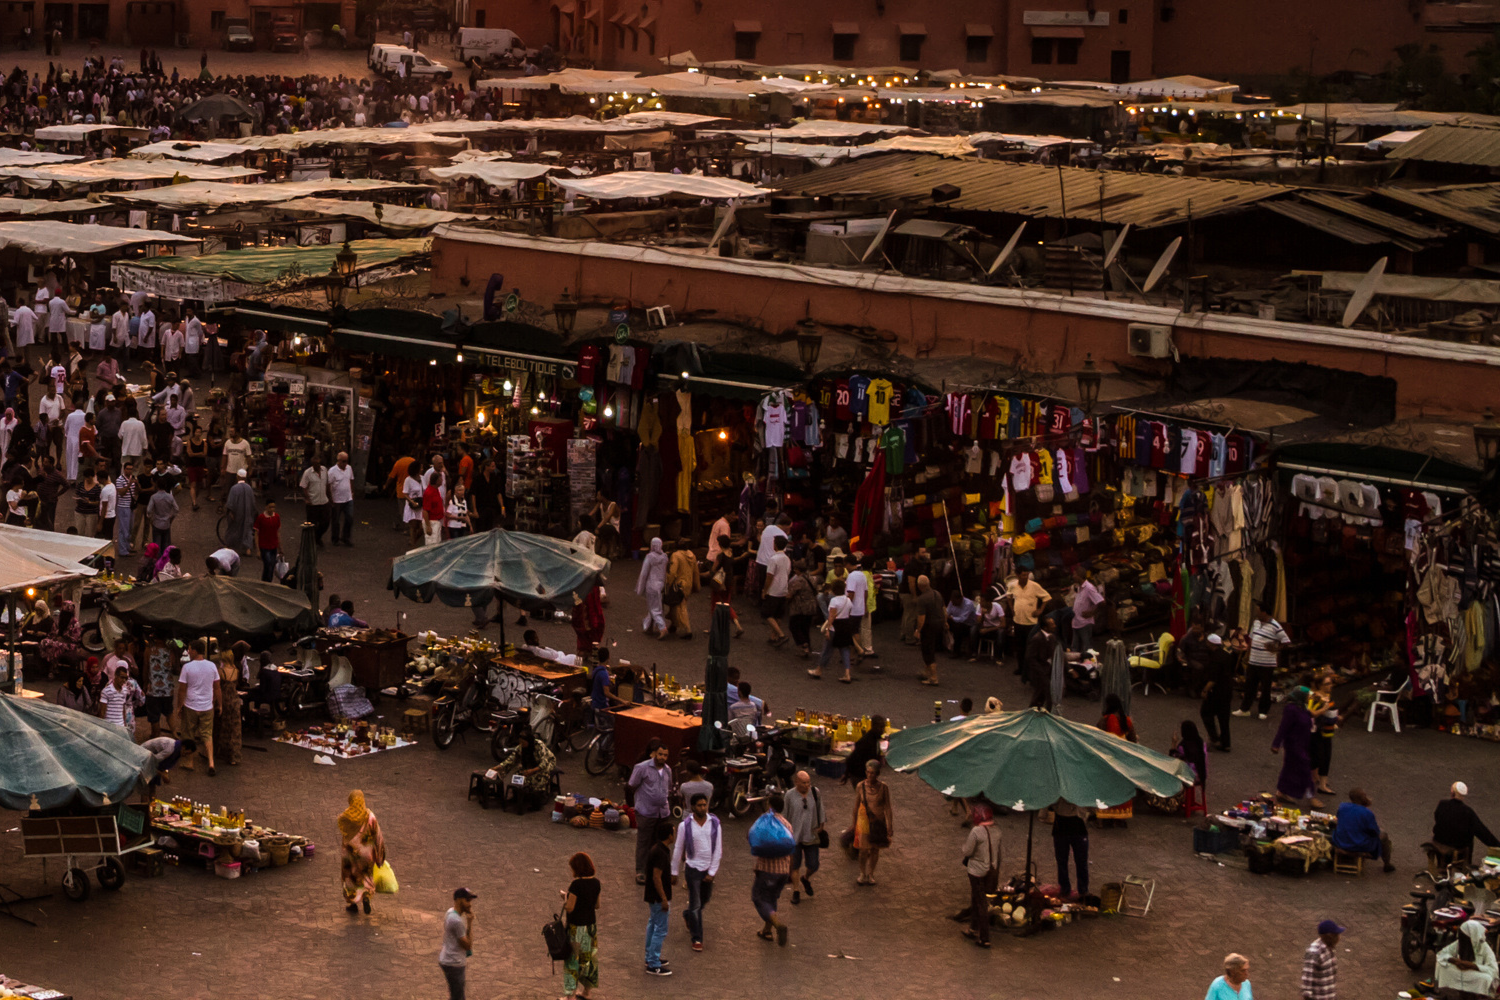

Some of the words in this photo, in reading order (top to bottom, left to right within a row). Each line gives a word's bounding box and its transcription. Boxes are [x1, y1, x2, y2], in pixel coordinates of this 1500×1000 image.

[485, 354, 558, 376] TELEBOUTIQUE
[836, 389, 850, 406] 20
[875, 390, 886, 405] 10
[1052, 414, 1063, 430] 31
[1152, 436, 1160, 450] 4
[1181, 442, 1189, 459] 7
[1228, 447, 1238, 462] 10
